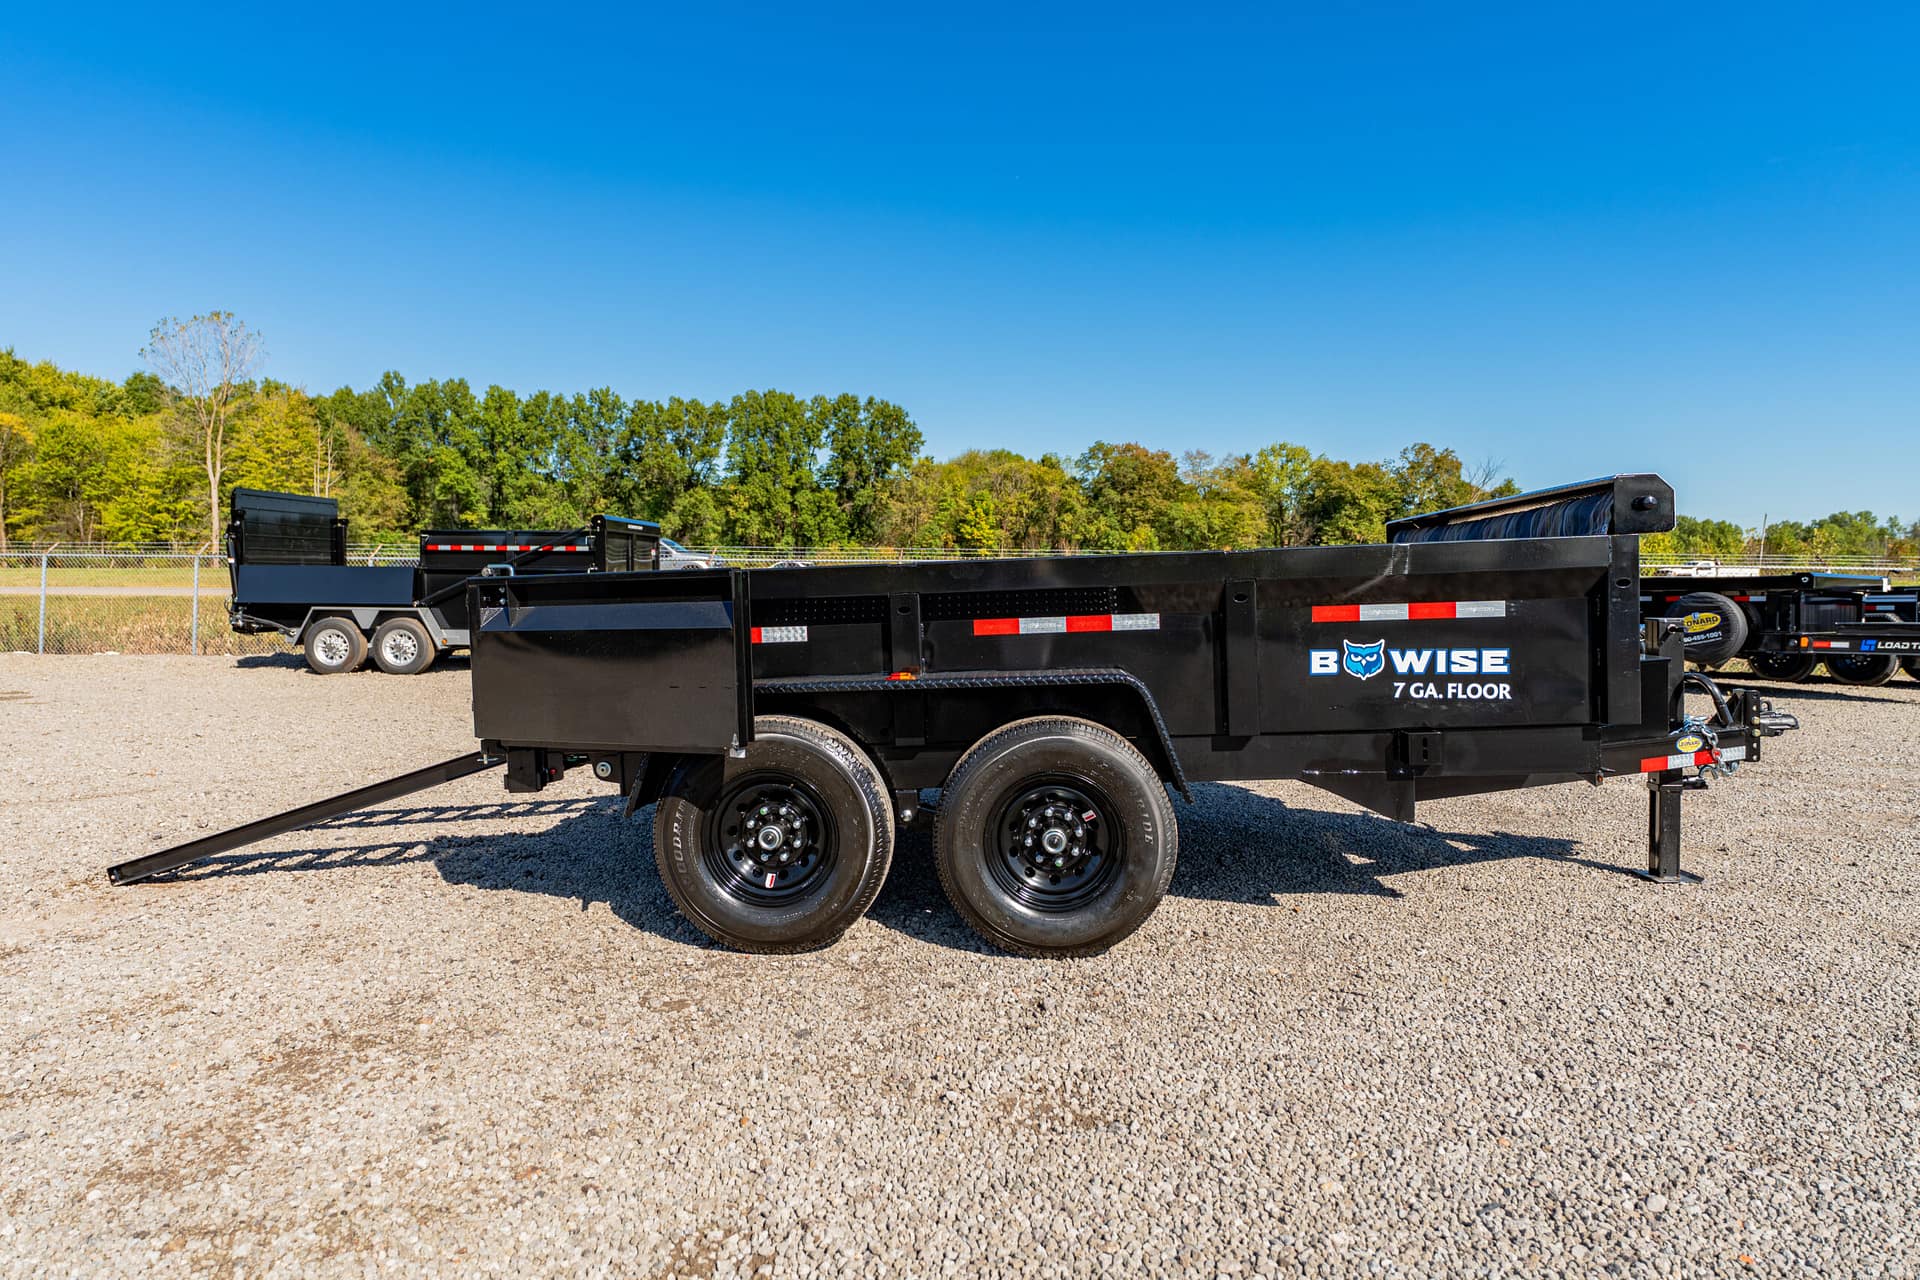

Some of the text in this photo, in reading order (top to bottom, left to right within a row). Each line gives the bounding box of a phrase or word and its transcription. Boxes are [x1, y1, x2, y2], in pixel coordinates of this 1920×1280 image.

[1686, 615, 1719, 627] ONARD
[1877, 641, 1920, 649] LOAD T
[1393, 682, 1512, 700] 7 GA. FLOOR
